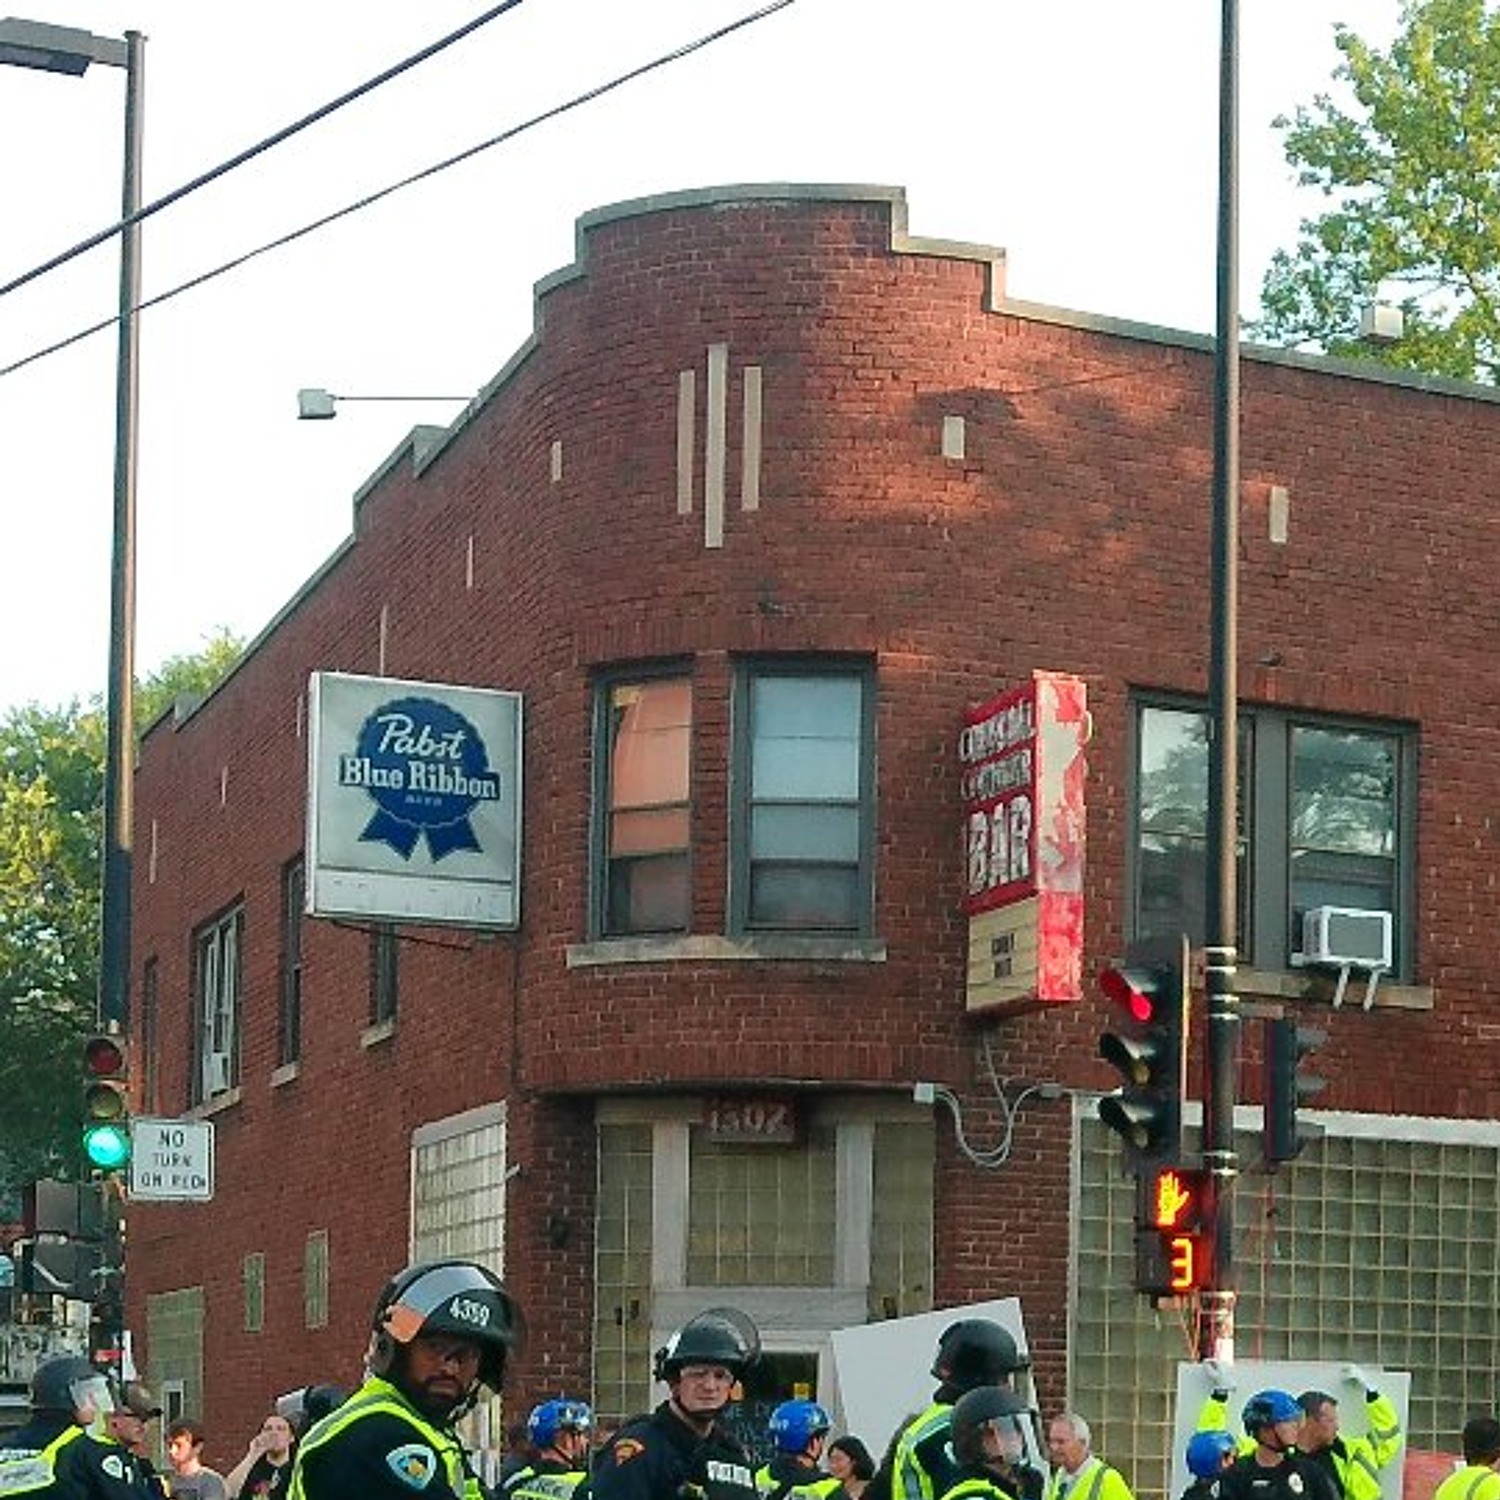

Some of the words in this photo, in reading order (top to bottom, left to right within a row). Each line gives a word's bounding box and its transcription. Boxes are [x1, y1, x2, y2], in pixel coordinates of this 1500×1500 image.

[377, 713, 467, 759] Pabst
[344, 755, 404, 789] Blue
[408, 760, 497, 798] Ribbon
[969, 795, 1031, 895] BAR
[153, 1152, 192, 1168] TURN
[159, 1129, 184, 1148] NO
[141, 1172, 161, 1187] ON
[172, 1174, 201, 1189] RED
[1170, 1237, 1193, 1288] 3
